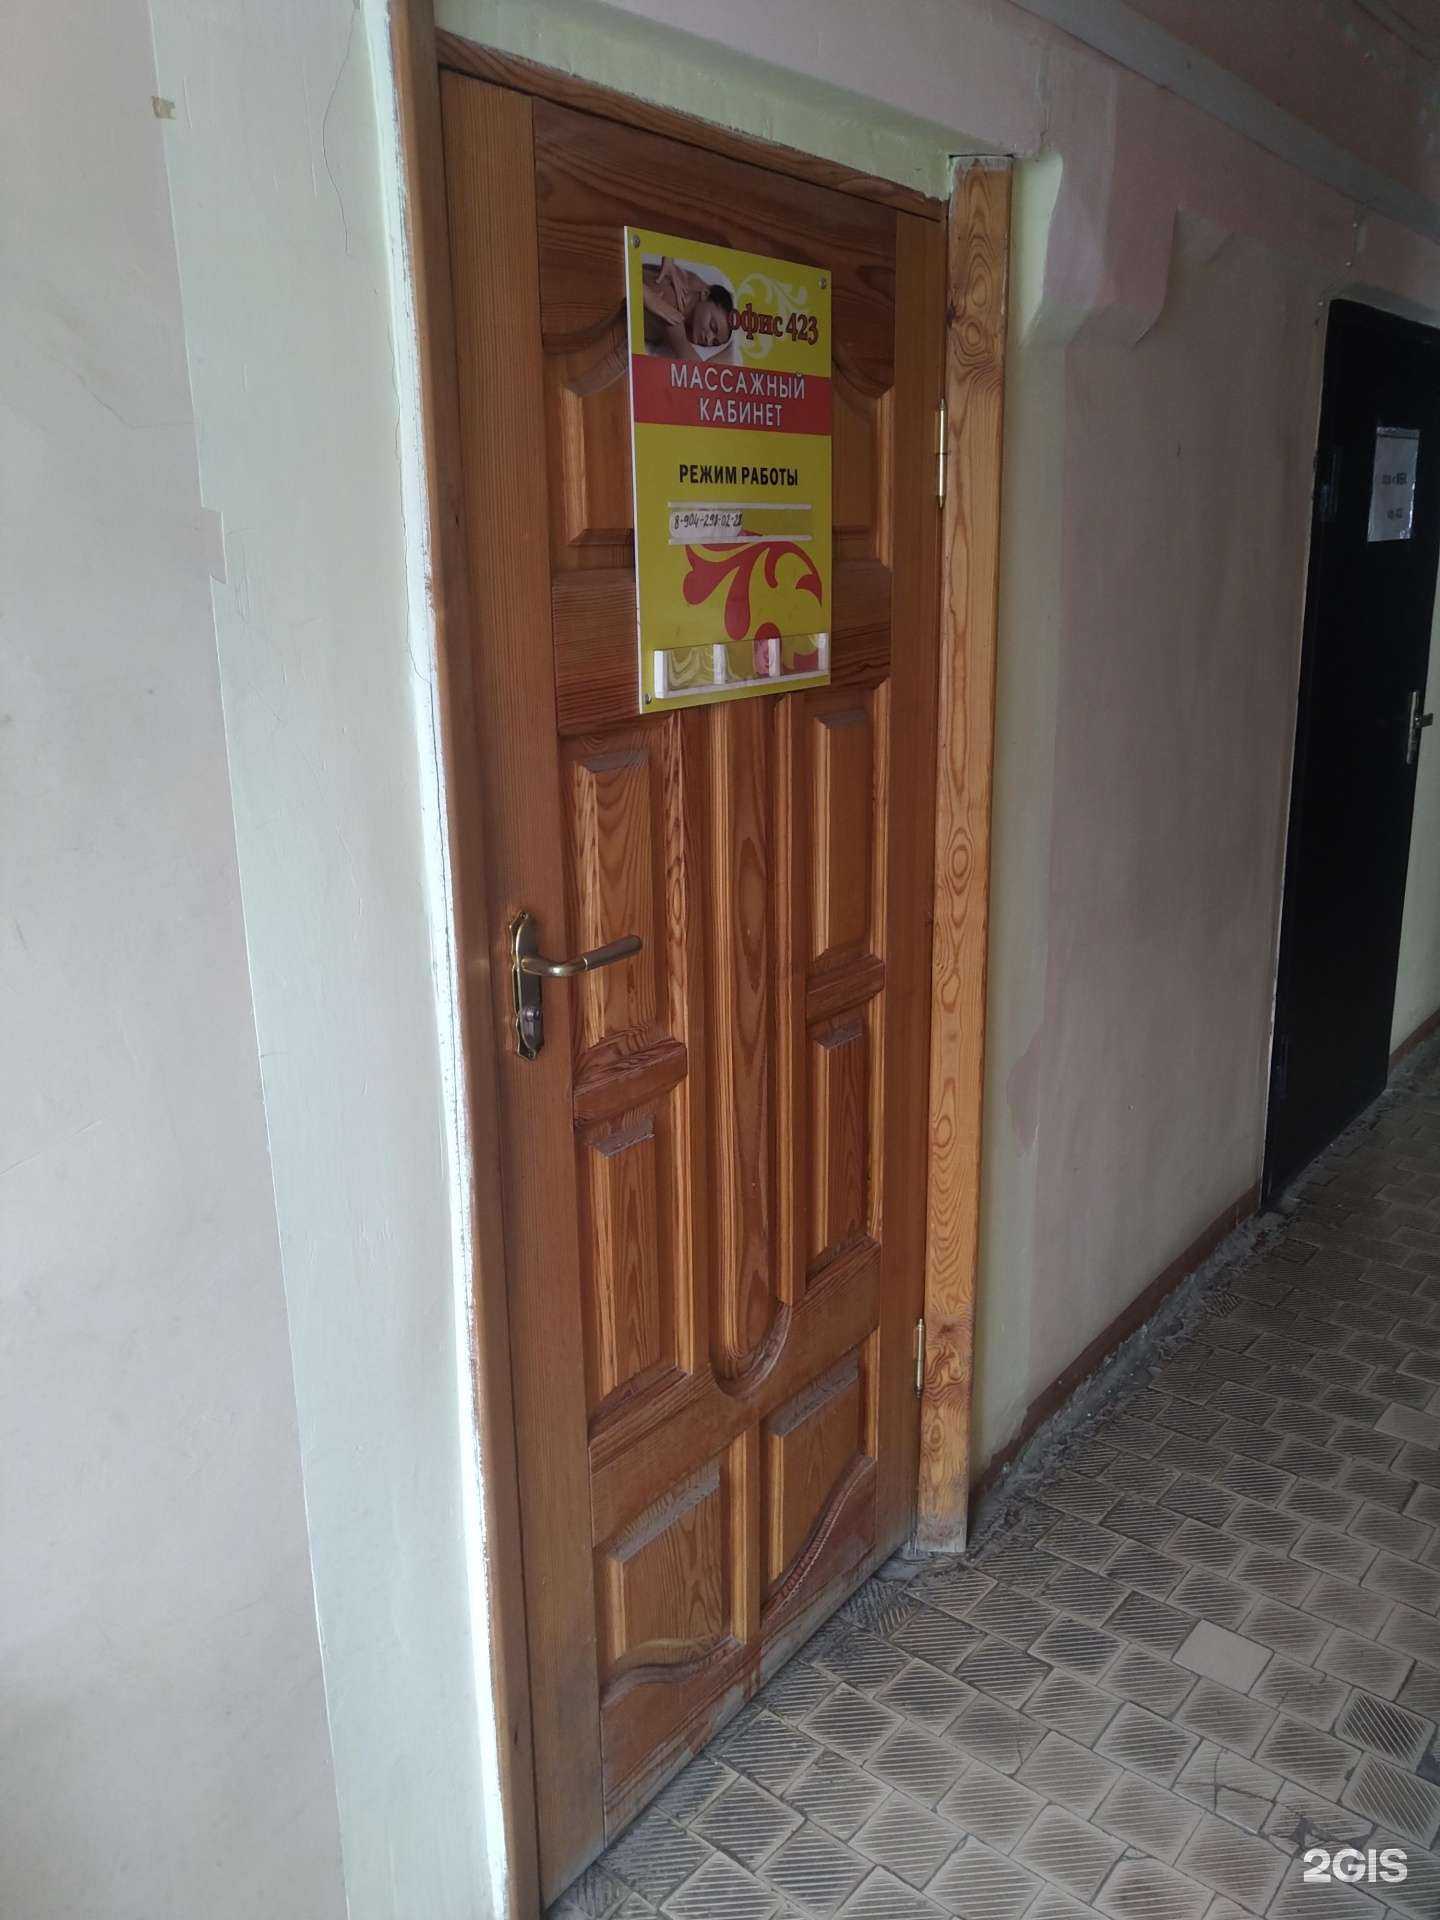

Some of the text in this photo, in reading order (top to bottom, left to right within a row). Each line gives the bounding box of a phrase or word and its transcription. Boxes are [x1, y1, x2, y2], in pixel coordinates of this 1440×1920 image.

[727, 303, 820, 345] офис 423
[670, 363, 805, 400] МАССАЖНЫЙ
[700, 397, 783, 427] КАБИНЕТ
[679, 464, 798, 486] РЕЖИМ РАБОТЫ
